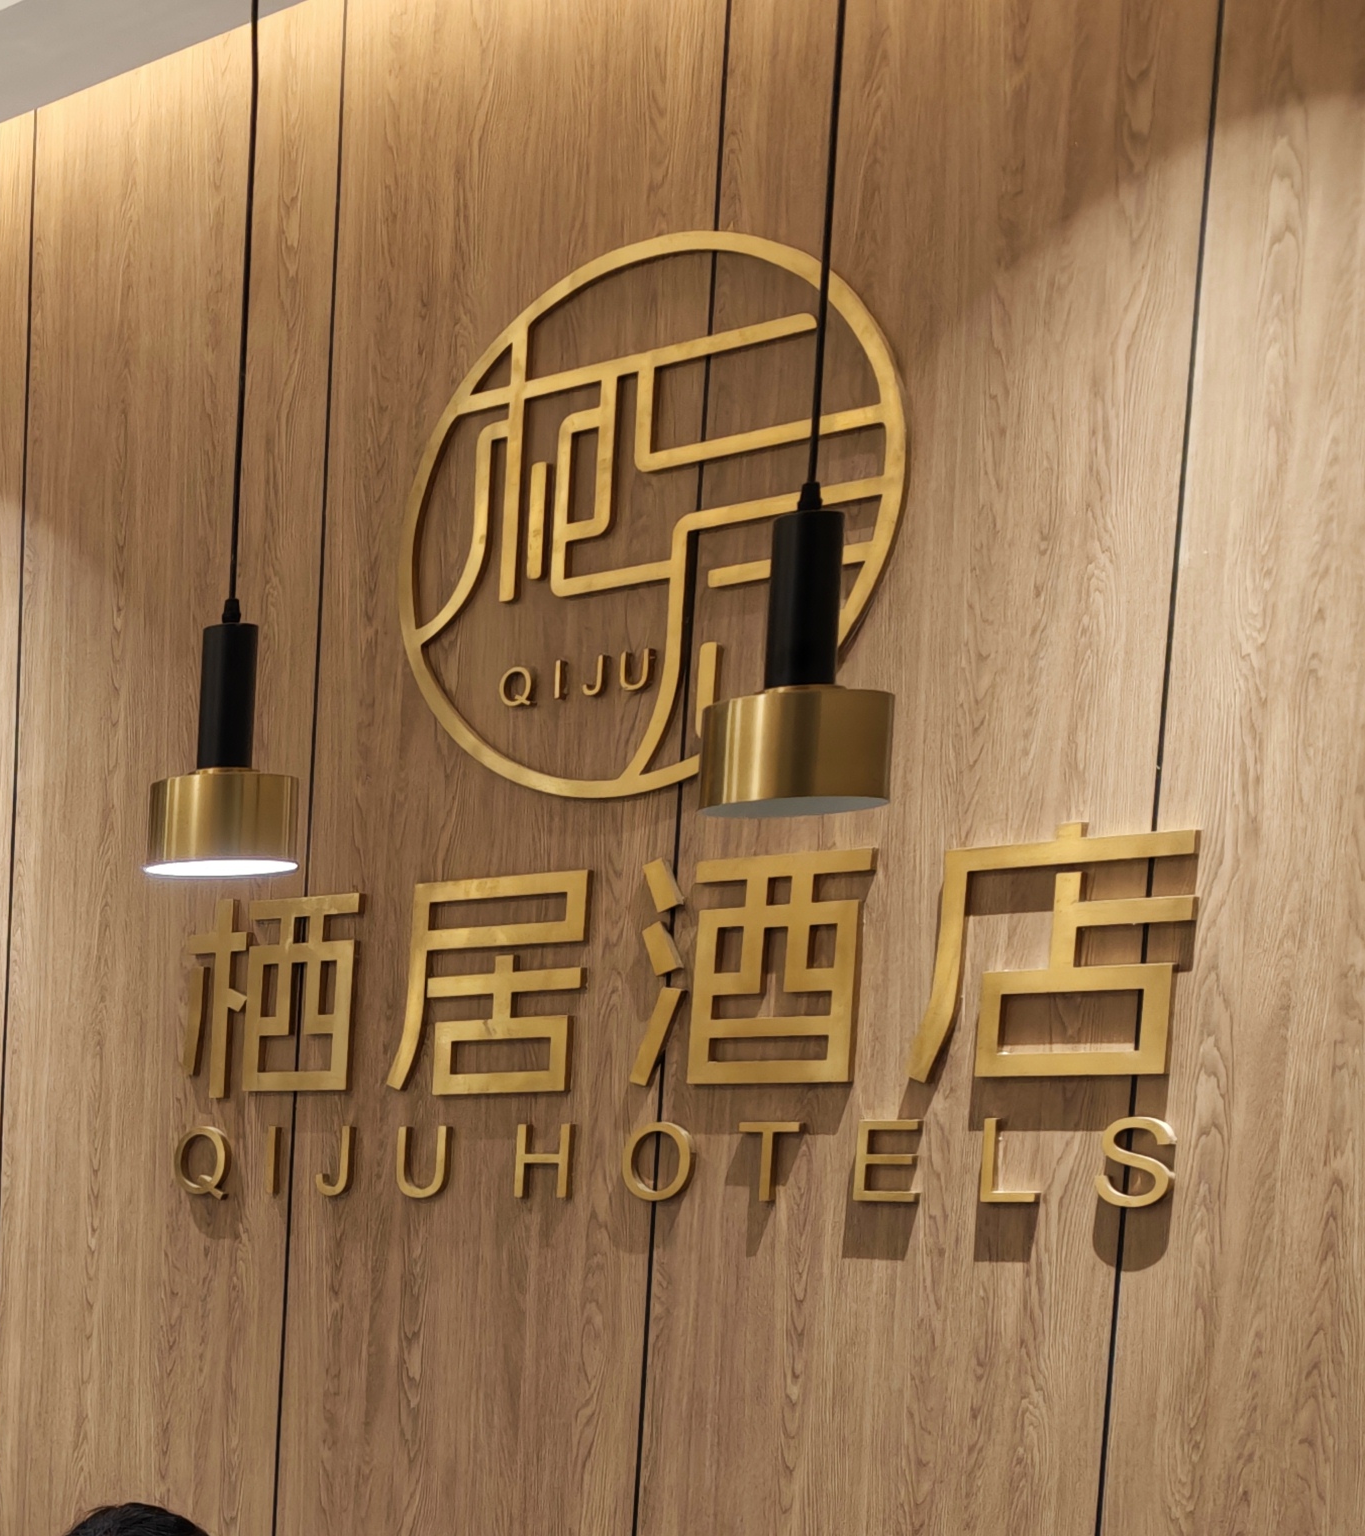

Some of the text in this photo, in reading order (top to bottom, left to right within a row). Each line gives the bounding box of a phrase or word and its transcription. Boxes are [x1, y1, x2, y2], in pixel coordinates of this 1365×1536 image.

[498, 647, 657, 708] QIJU
[178, 821, 1201, 1101] 栖居酒店
[172, 1116, 1177, 1209] QIJU HOTELS
